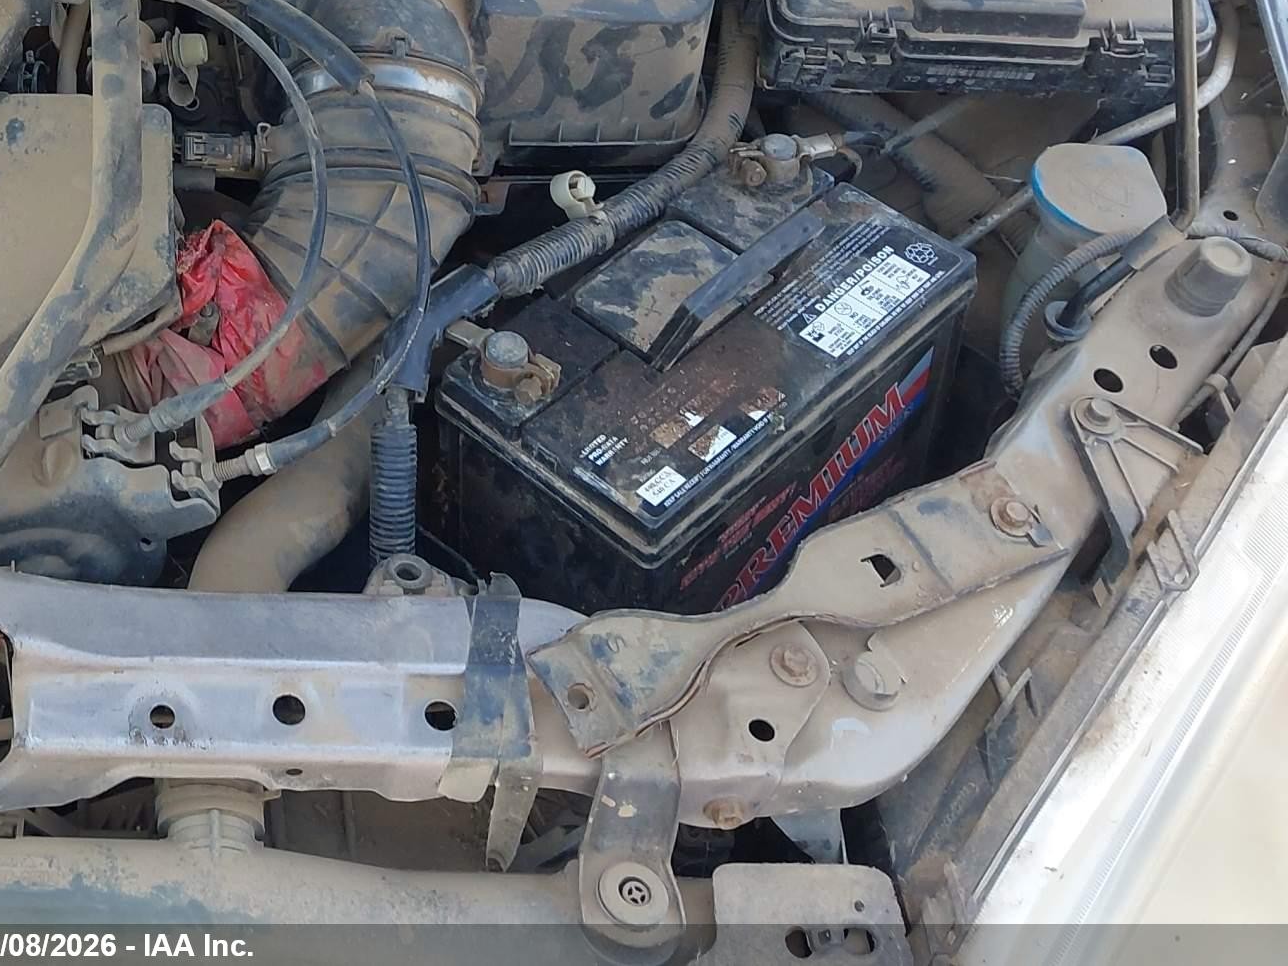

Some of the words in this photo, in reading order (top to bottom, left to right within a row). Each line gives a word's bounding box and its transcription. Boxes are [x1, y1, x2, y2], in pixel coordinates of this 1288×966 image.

[814, 244, 895, 313] DANGER/POISON
[596, 436, 630, 466] WARRANTY
[713, 381, 905, 611] PREMIUM
